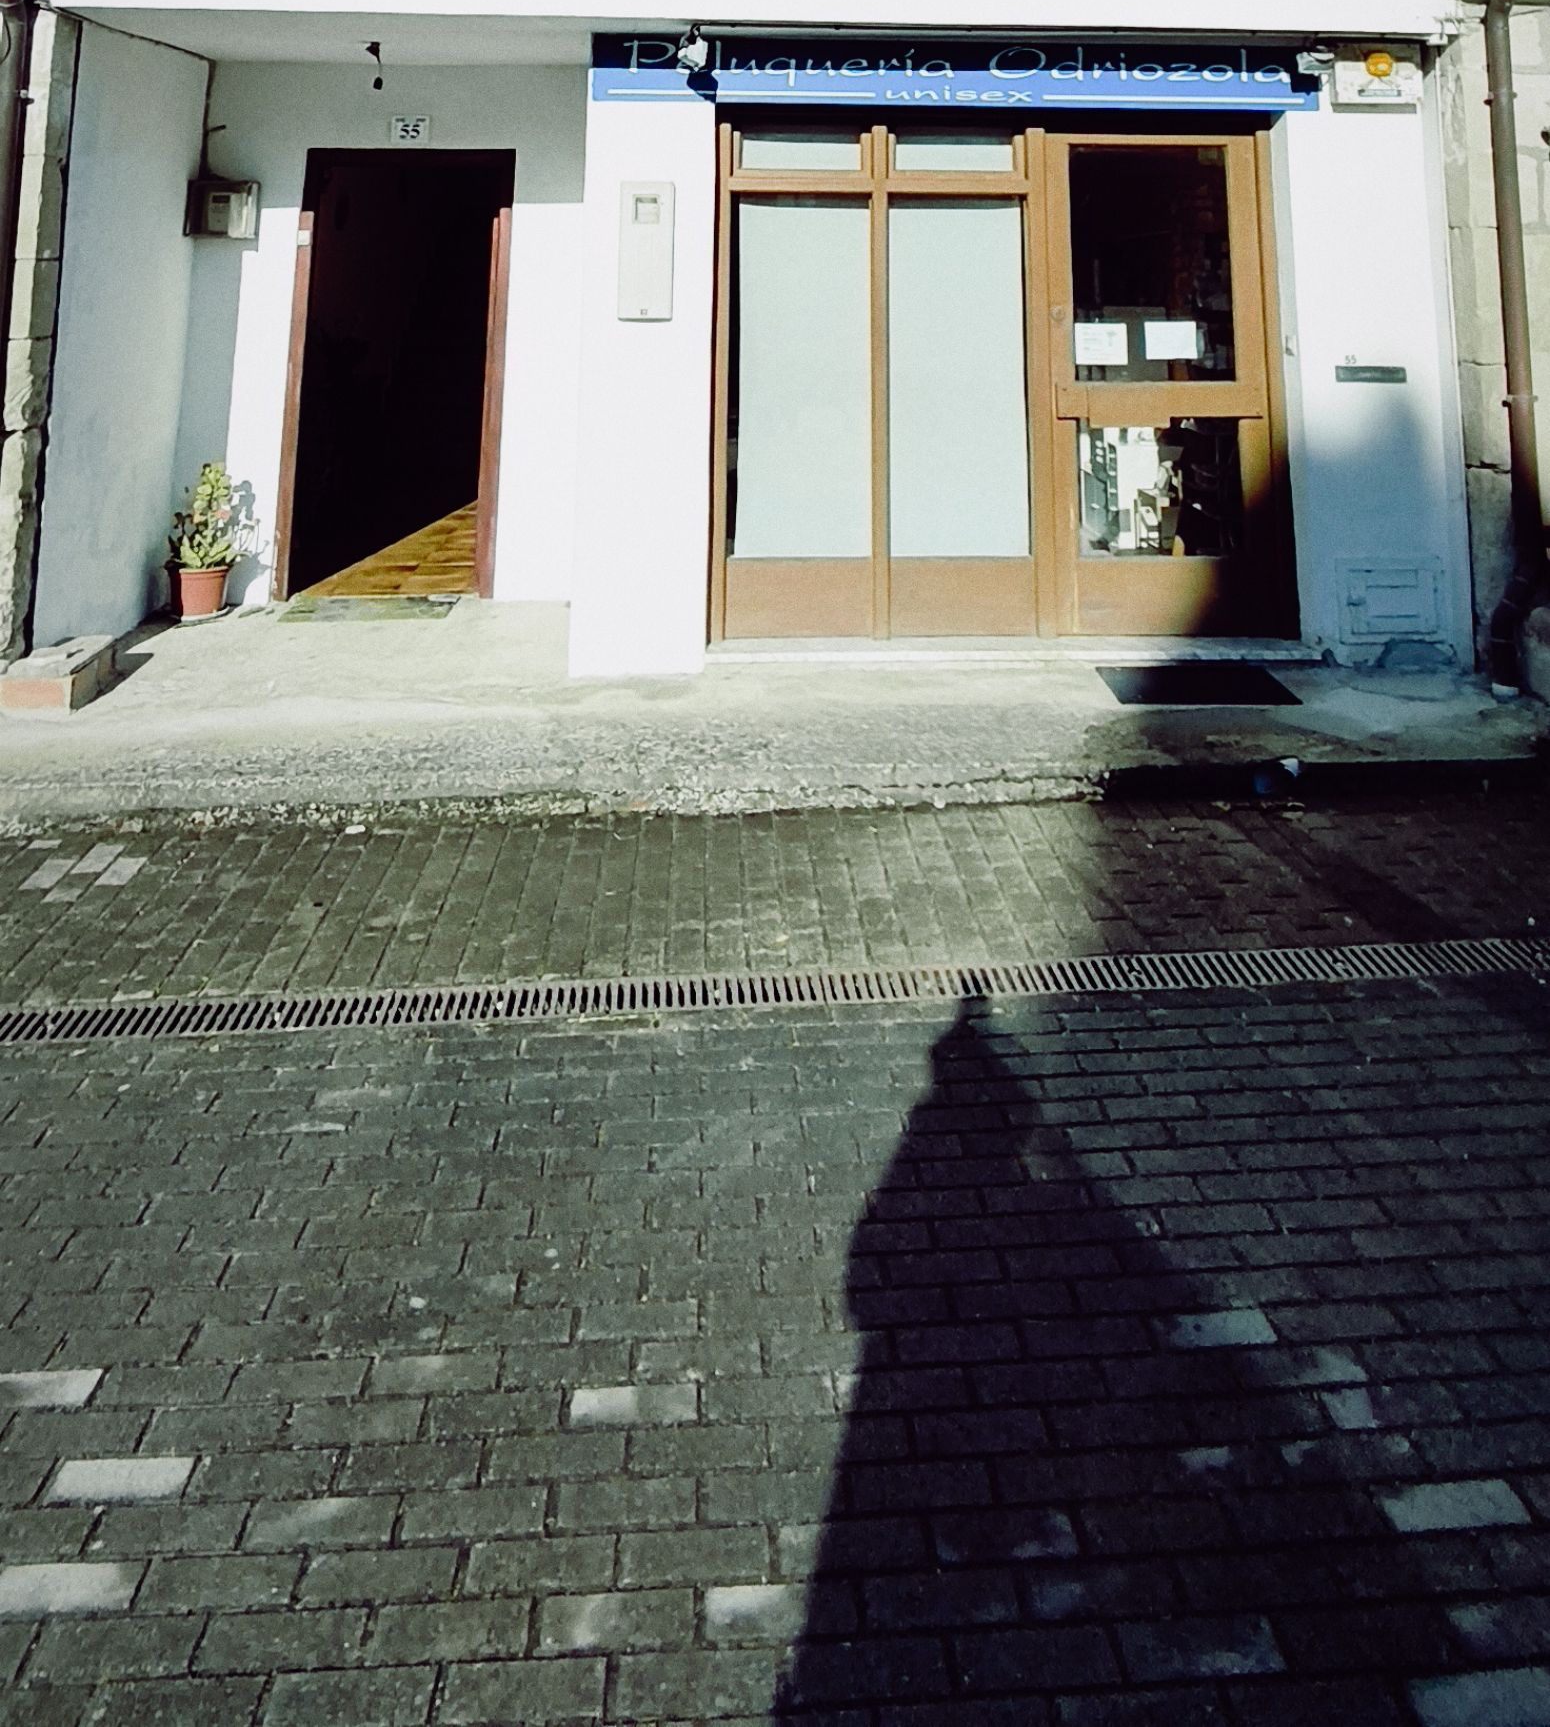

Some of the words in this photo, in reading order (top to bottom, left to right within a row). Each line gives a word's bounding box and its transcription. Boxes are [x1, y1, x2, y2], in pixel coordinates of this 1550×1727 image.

[989, 46, 1291, 84] Odriozola
[885, 85, 1033, 104] unisex
[399, 123, 420, 139] 55
